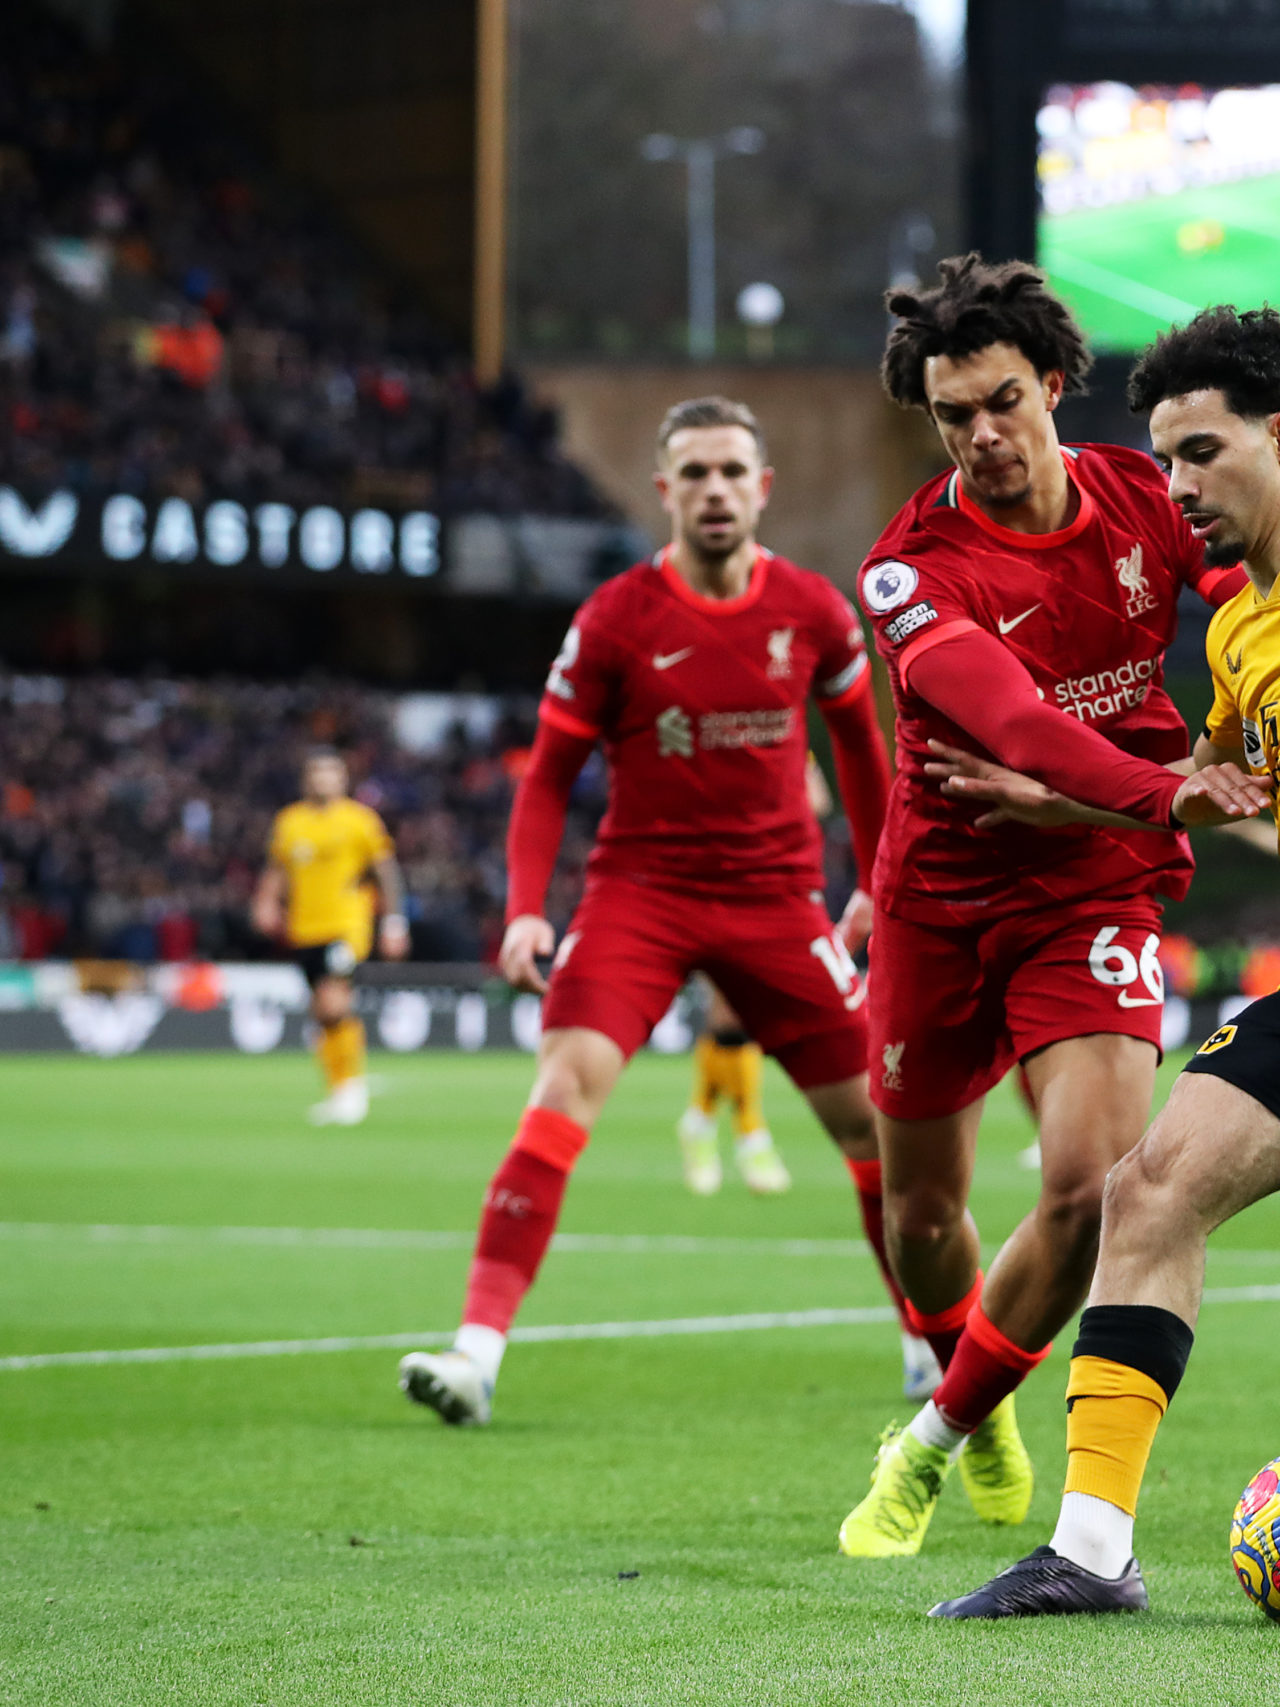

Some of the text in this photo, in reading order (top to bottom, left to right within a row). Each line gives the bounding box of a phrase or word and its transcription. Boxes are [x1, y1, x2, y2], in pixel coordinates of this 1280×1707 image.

[101, 494, 441, 578] CASTORE
[895, 603, 928, 628] room
[1126, 594, 1160, 619] LFC
[1088, 926, 1164, 1004] 66
